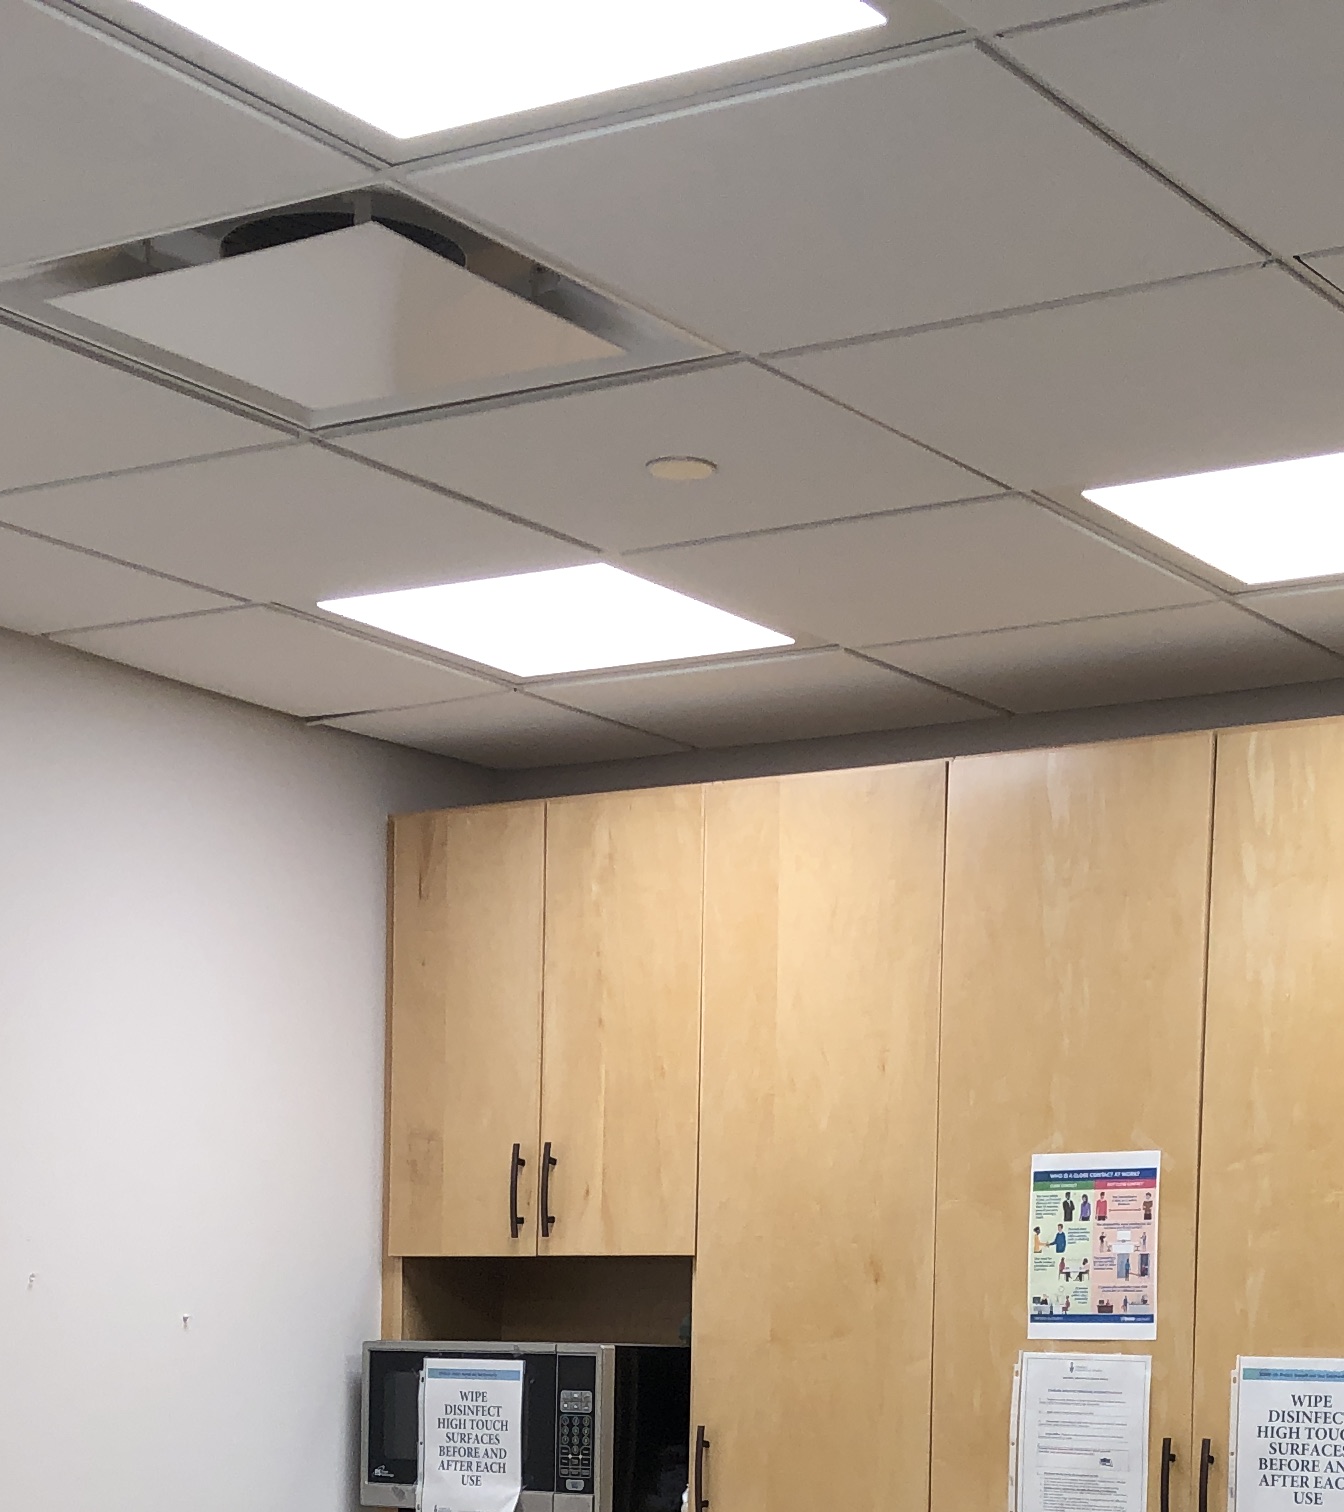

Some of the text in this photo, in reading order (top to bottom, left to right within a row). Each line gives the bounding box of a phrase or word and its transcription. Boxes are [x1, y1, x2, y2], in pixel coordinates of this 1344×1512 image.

[460, 1391, 487, 1402] WIPE
[1291, 1394, 1332, 1408] WIPE
[445, 1404, 502, 1417] DISINFECT
[437, 1418, 508, 1431] HIGH TOUCH
[445, 1432, 500, 1445] SURFACES
[1257, 1426, 1300, 1439] HIGH
[439, 1446, 507, 1459] BEFORE AND
[438, 1460, 506, 1473] AFTER EACH
[1259, 1458, 1320, 1472] BEFORE
[461, 1475, 481, 1486] USE
[1259, 1474, 1309, 1488] AFTER
[1294, 1492, 1323, 1505] USE
